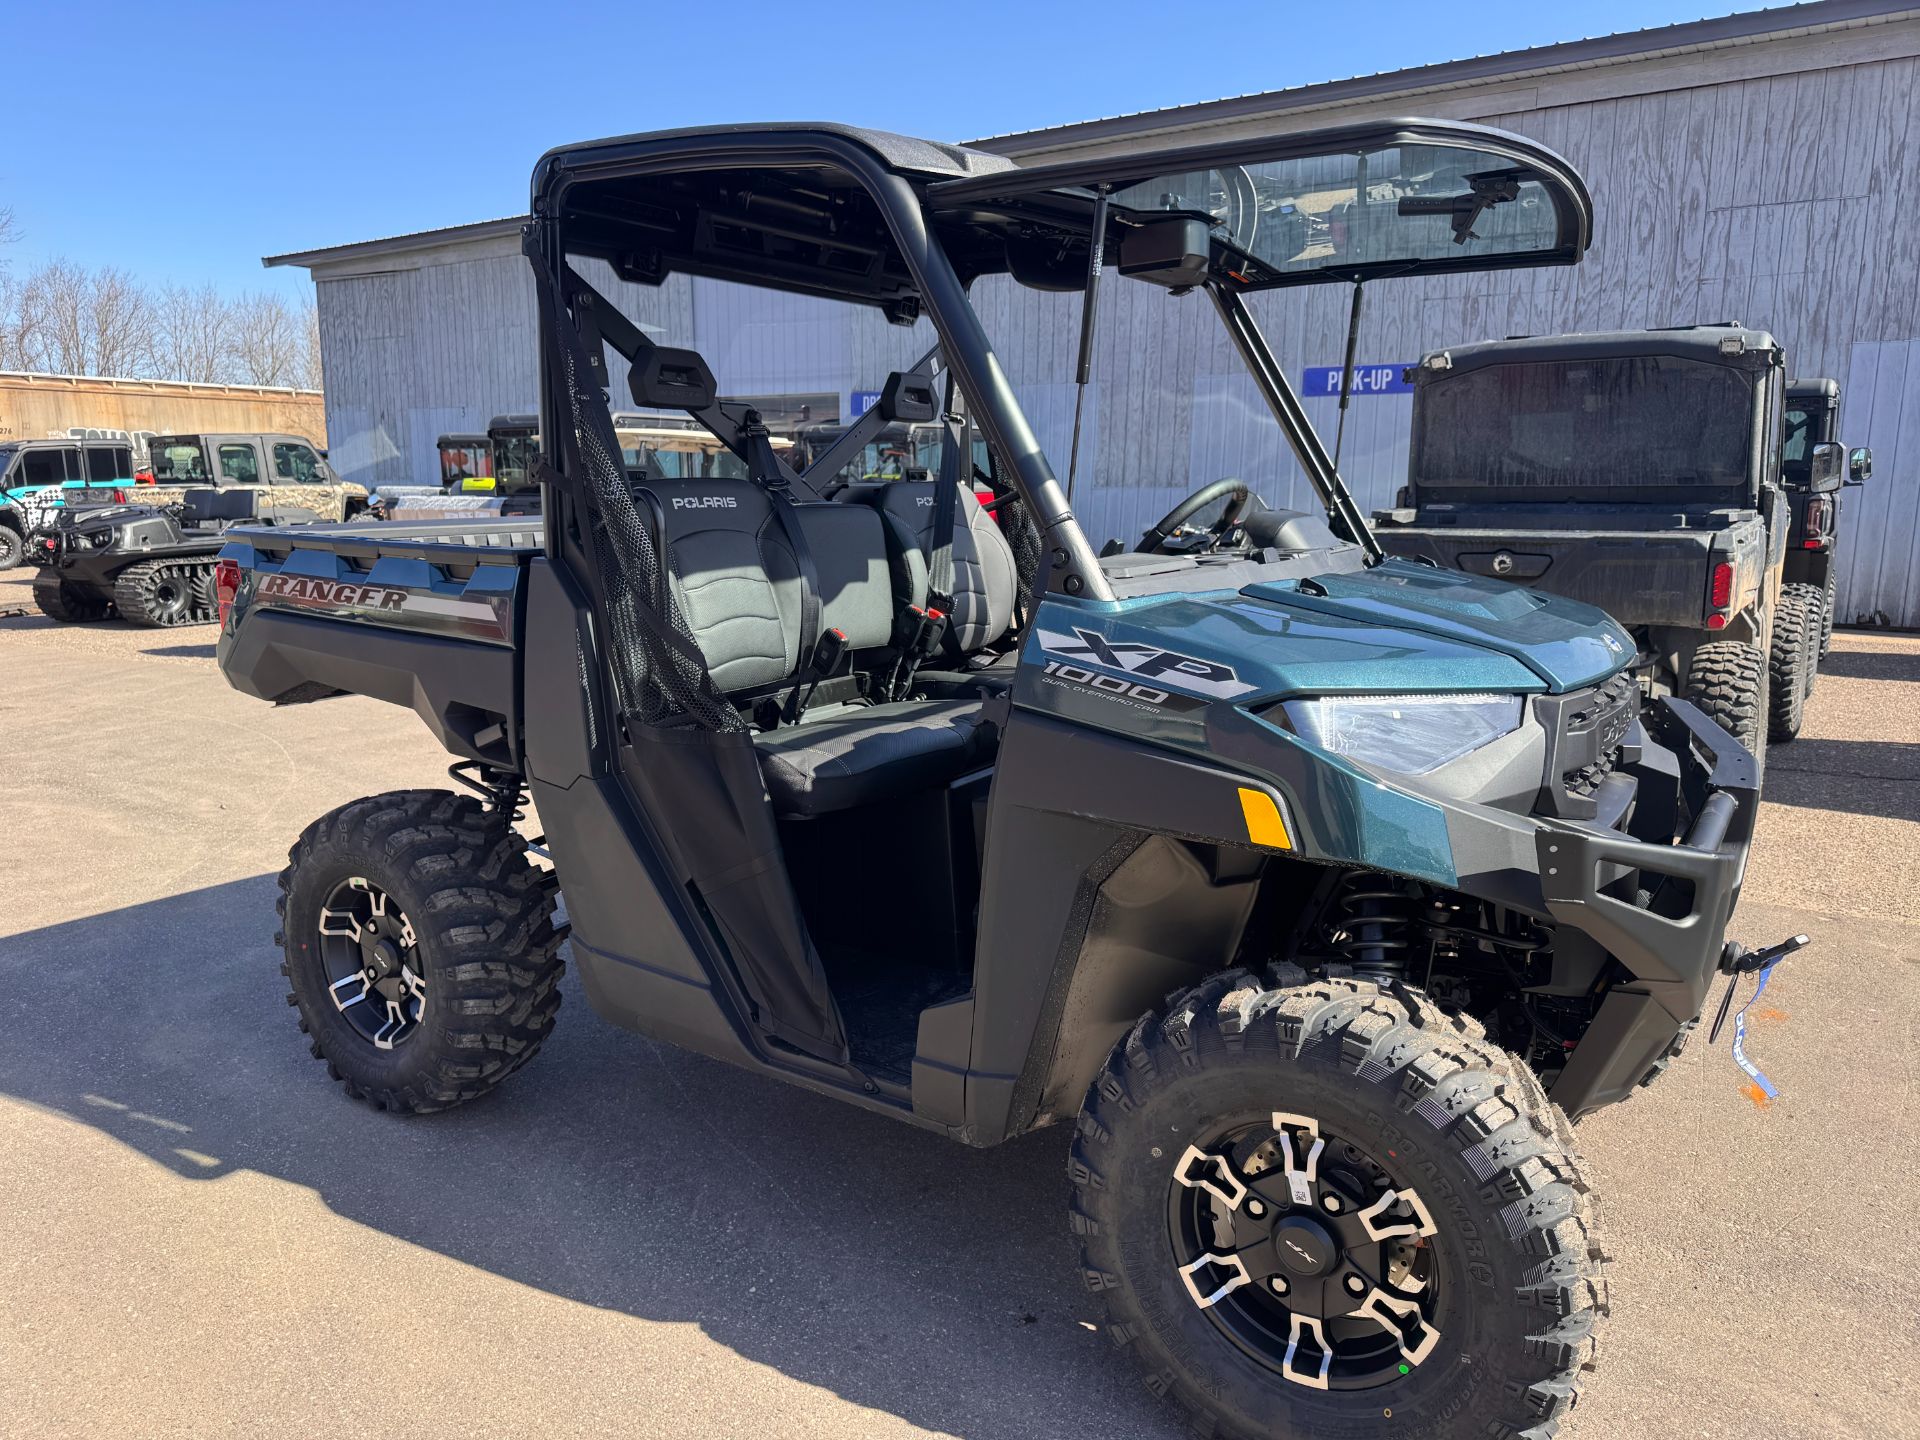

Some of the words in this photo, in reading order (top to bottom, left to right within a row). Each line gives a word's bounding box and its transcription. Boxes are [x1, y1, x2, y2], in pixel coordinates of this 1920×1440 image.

[1327, 368, 1393, 392] PIK-UP
[672, 497, 738, 510] POLARIS
[264, 574, 408, 613] RANGER
[1040, 626, 1246, 692] XP
[1042, 677, 1070, 689] DUAL
[1072, 686, 1133, 706] OVERHEAD
[1134, 703, 1161, 714] CAM
[1043, 661, 1170, 704] 1000
[1734, 1011, 1759, 1077] OLARIS
